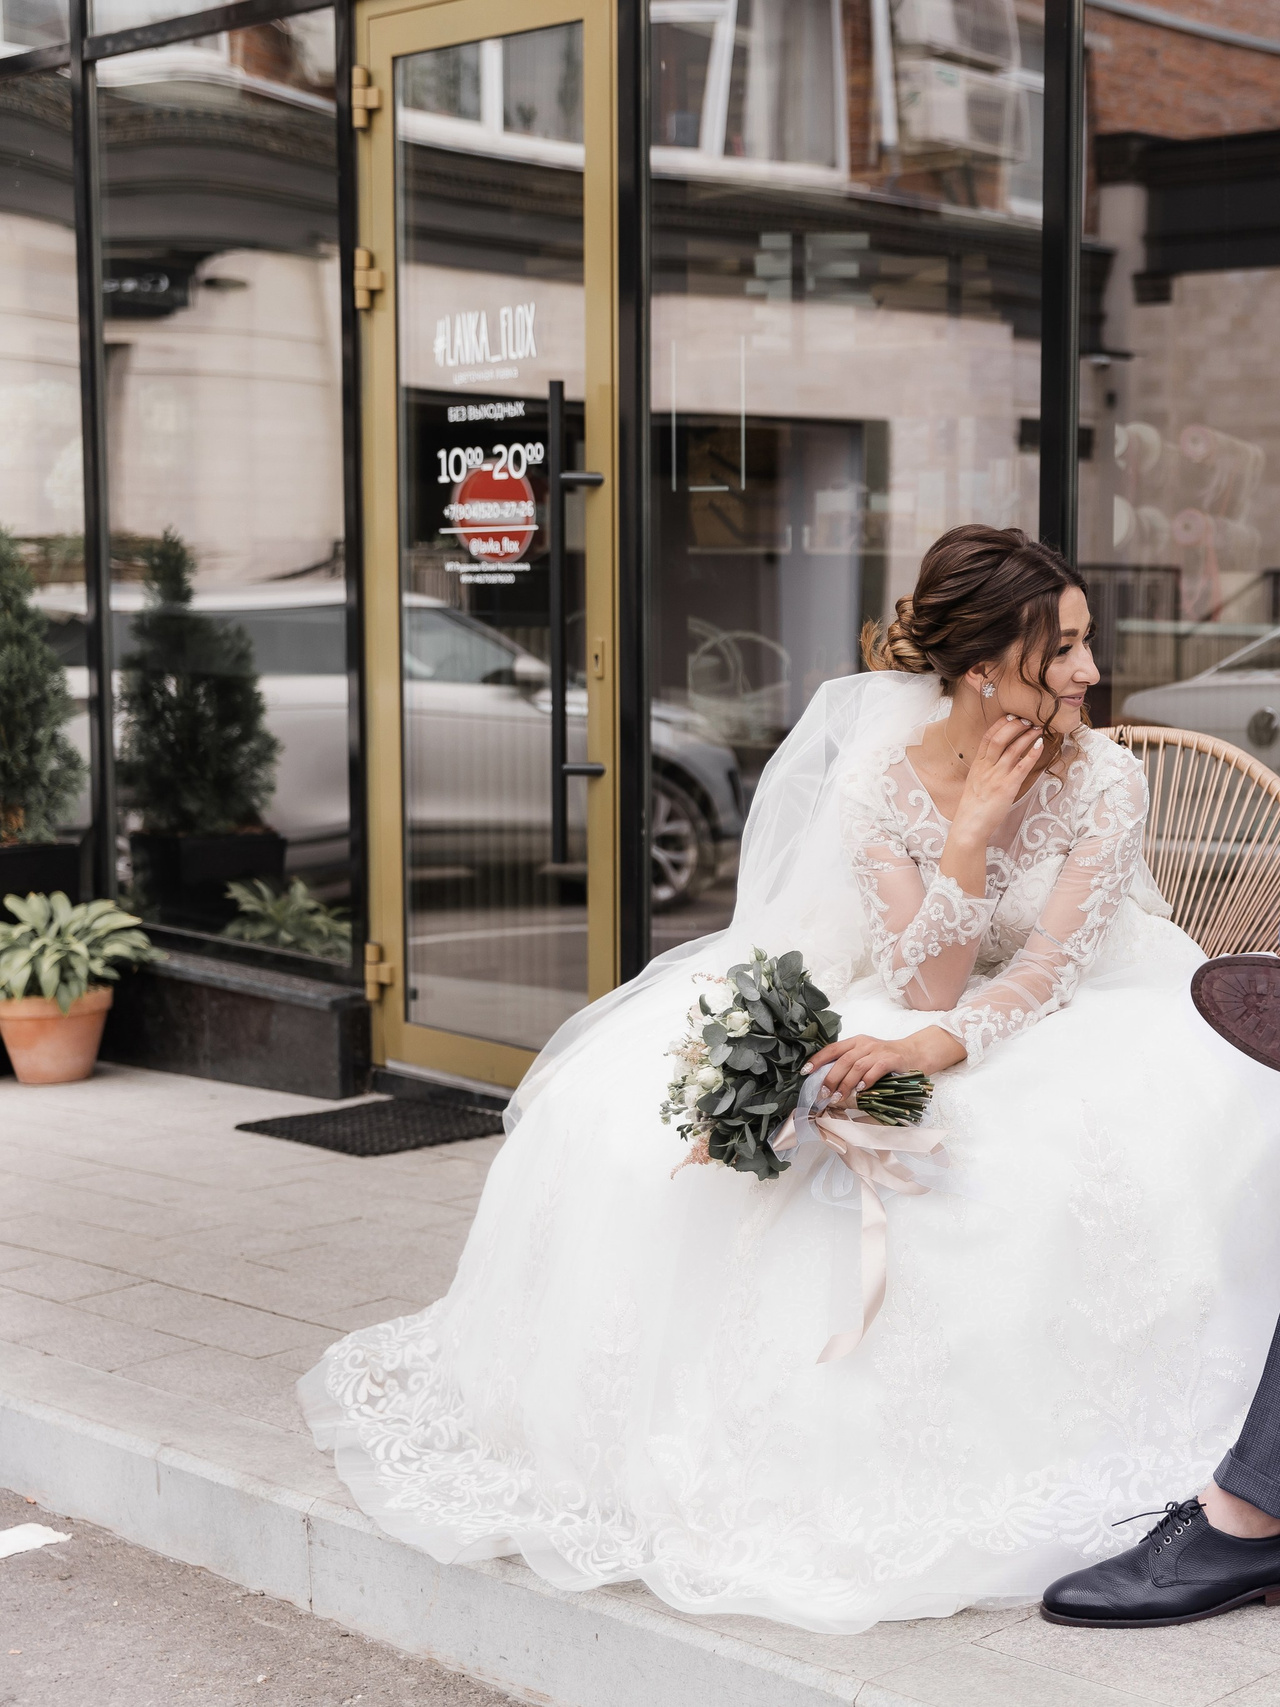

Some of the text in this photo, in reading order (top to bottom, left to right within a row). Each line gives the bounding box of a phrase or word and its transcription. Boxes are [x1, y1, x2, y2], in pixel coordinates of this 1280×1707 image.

[447, 401, 525, 423] БЕЗ ВЫХОДНЫХ
[469, 537, 520, 556] @lavka_flox
